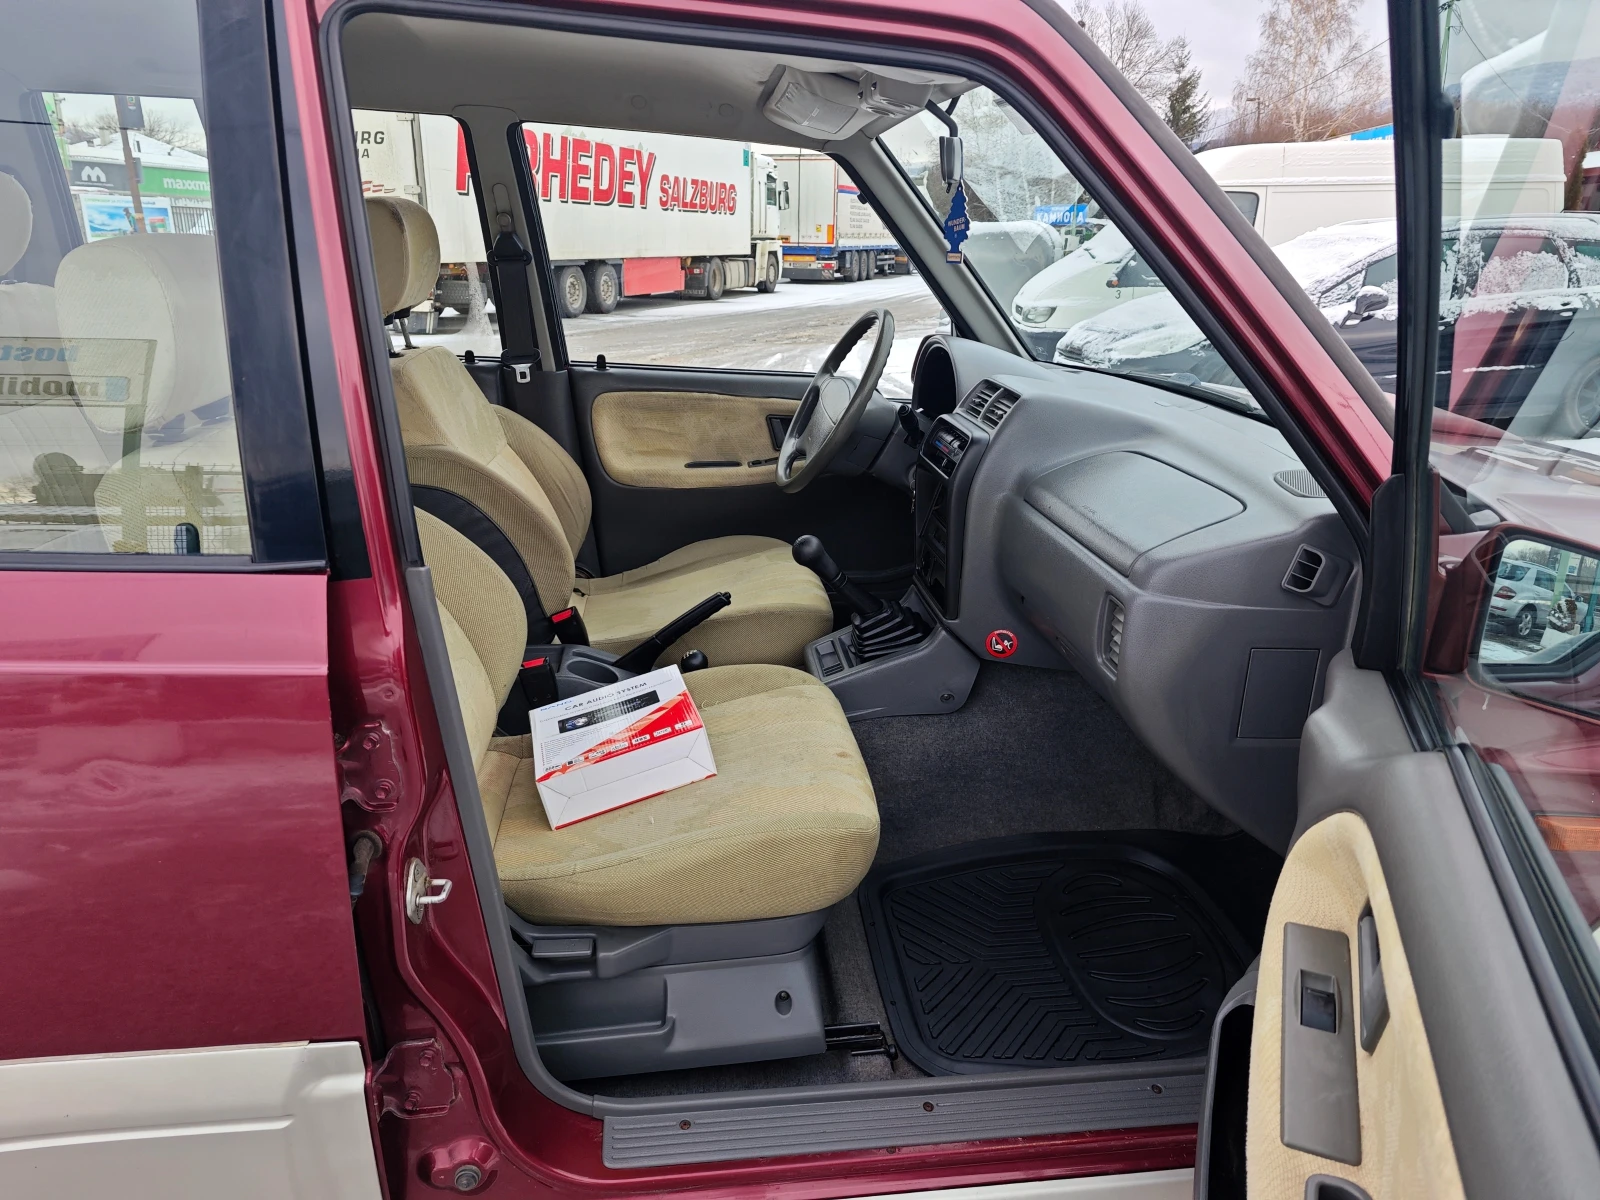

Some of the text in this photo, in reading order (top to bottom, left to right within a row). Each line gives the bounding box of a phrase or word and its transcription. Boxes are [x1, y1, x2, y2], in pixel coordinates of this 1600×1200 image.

[659, 174, 738, 216] SALZBURG
[1114, 289, 1122, 299] 3
[564, 702, 585, 711] CAR
[586, 693, 614, 704] AUDIO
[616, 682, 648, 695] SYSTEM
